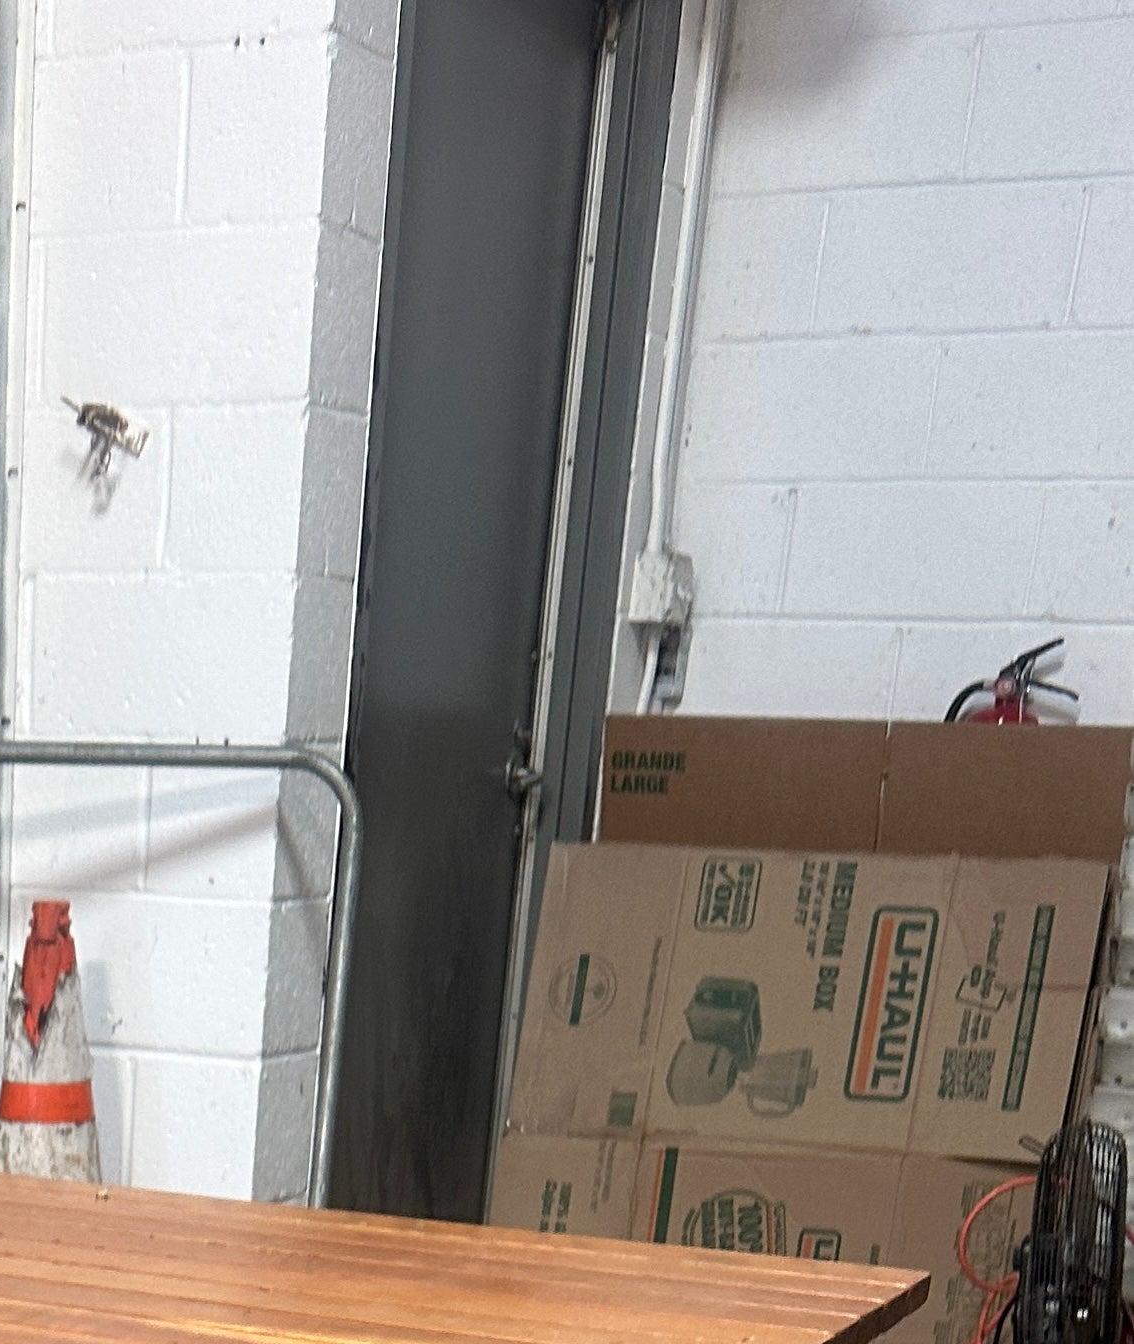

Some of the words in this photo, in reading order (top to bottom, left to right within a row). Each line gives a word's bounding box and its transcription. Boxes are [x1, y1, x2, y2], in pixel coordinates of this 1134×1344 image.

[612, 751, 686, 772] GRANDE
[610, 774, 668, 793] LARGE
[822, 861, 858, 957] MEDIUM
[814, 965, 840, 1012] BOX
